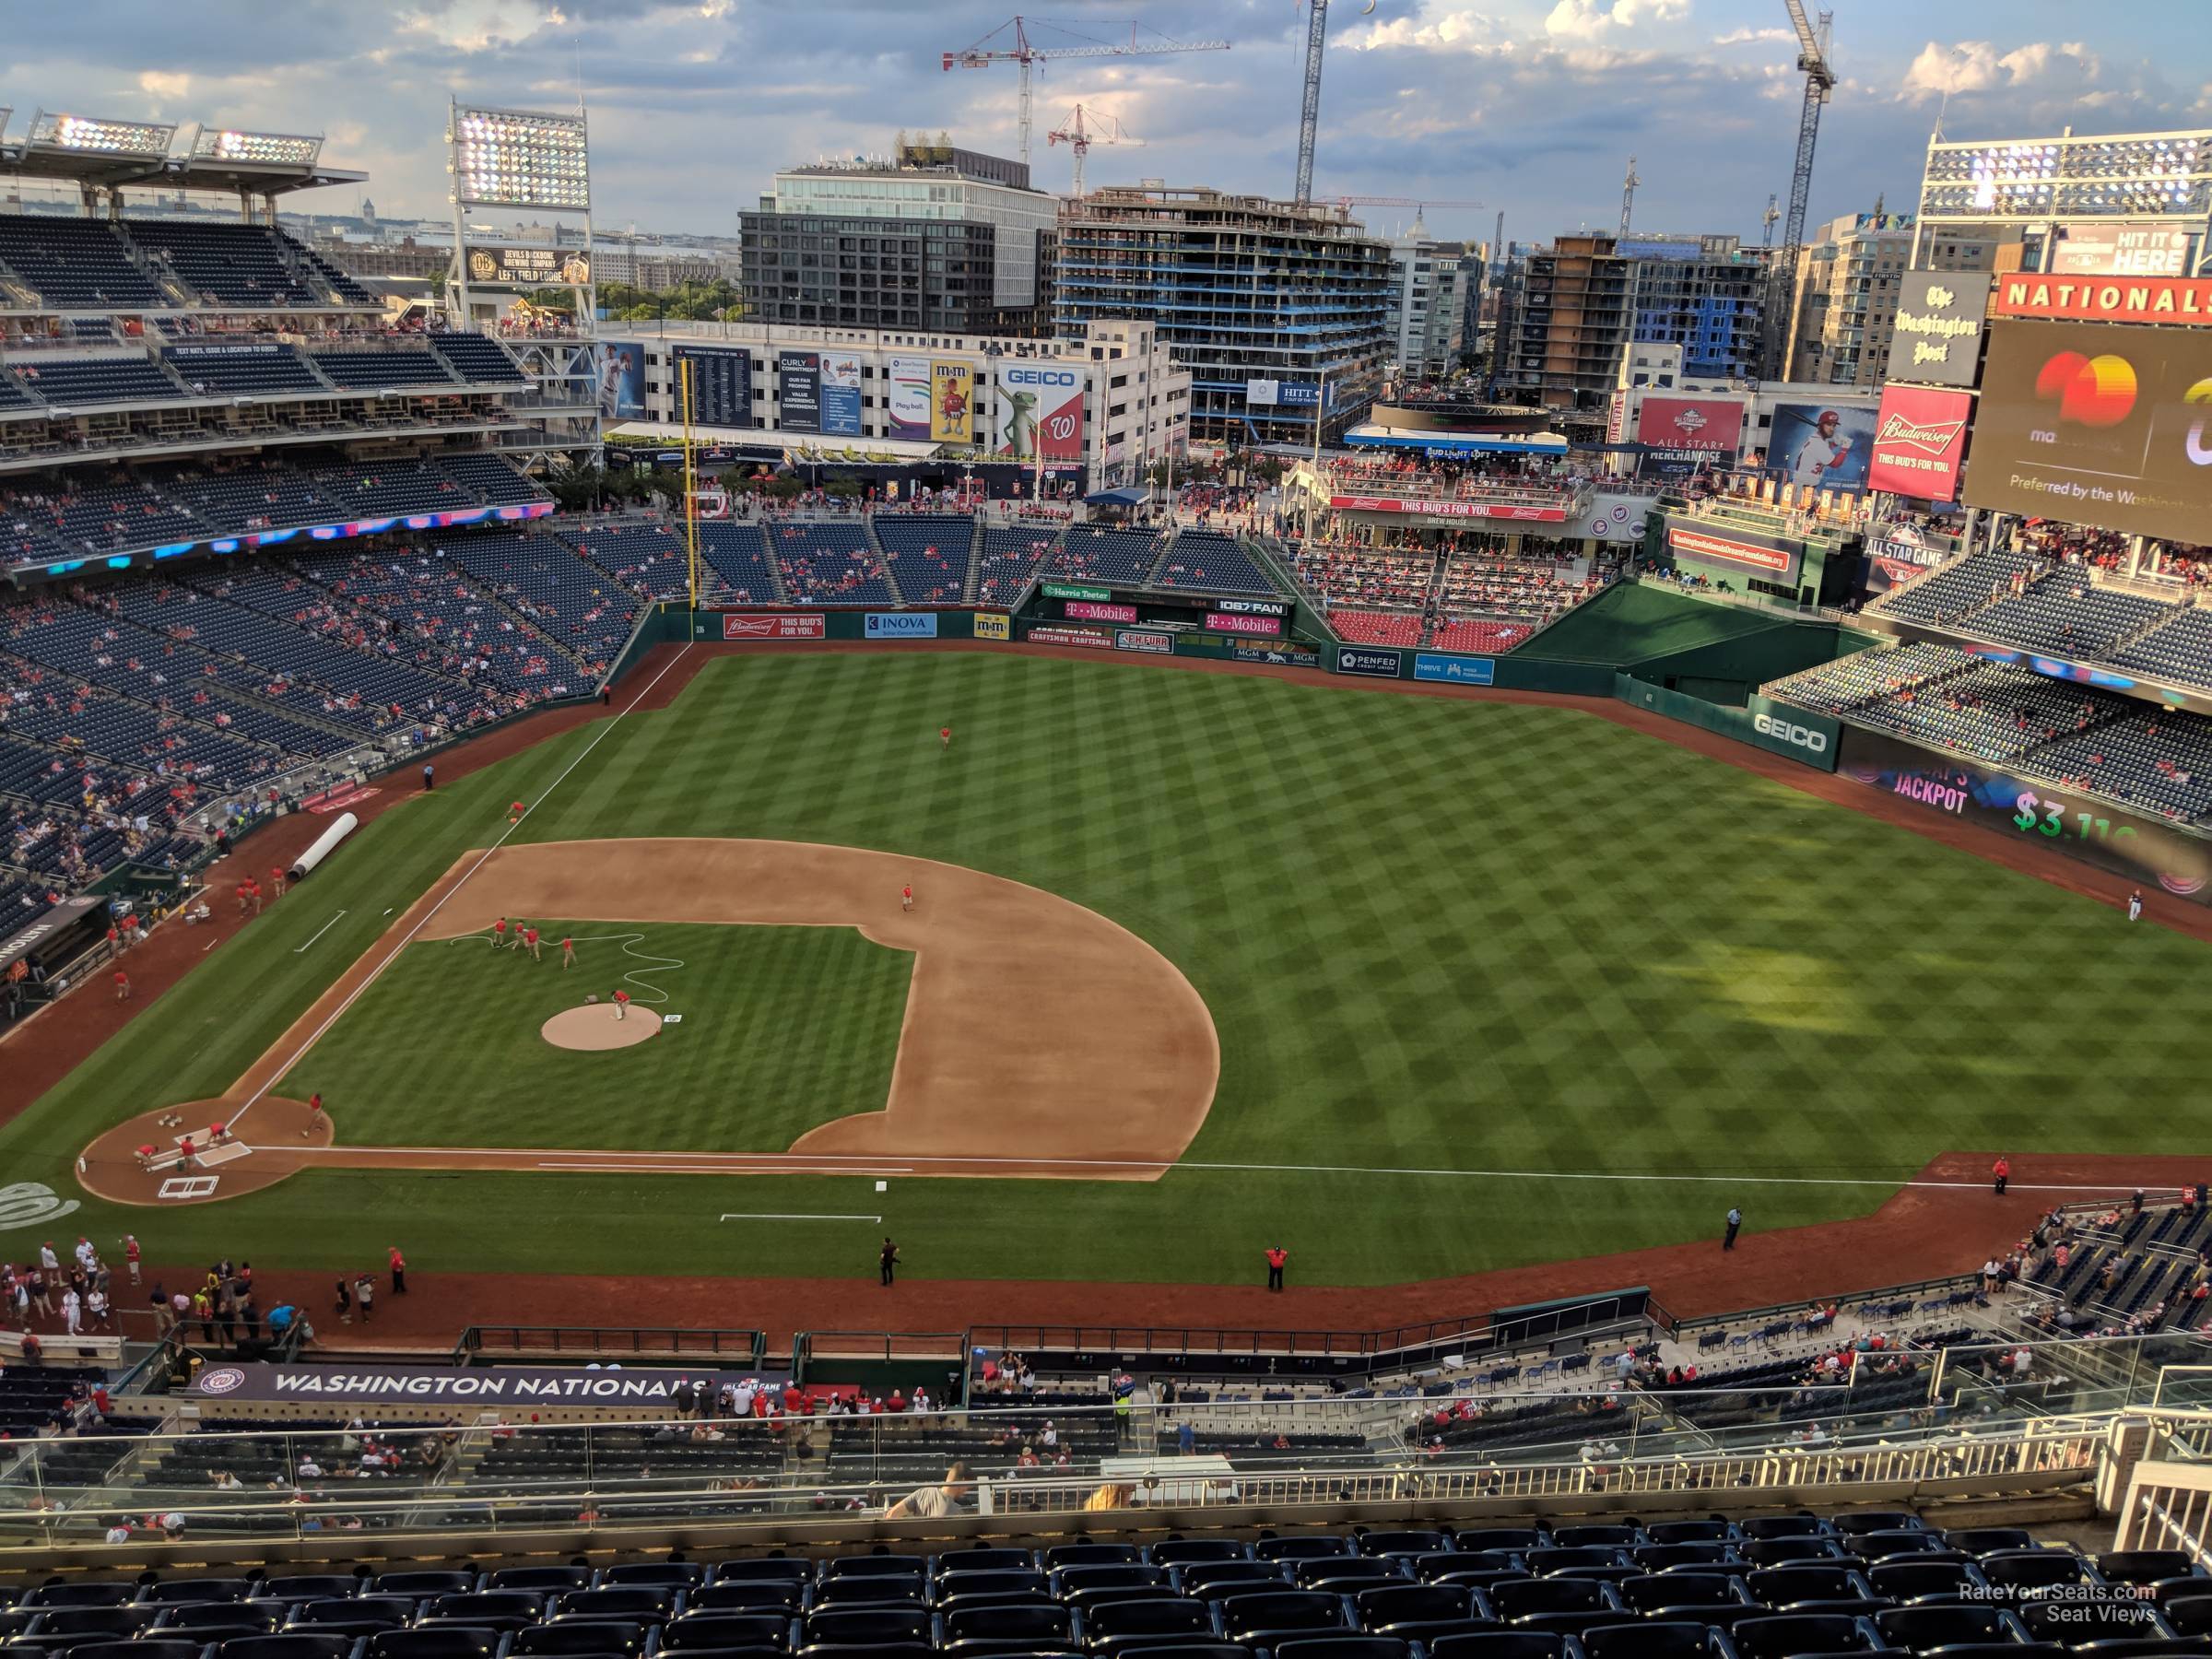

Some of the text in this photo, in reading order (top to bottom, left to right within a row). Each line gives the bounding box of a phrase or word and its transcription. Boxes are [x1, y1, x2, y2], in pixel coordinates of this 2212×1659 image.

[2118, 232, 2169, 247] HIT IT
[525, 251, 554, 260] BACKBONE
[2113, 249, 2183, 271] HERE
[504, 259, 556, 268] BREWING COMPANY
[499, 269, 563, 282] LEFT FIELD LODGE
[1926, 286, 1955, 309] The
[1894, 308, 1979, 338] Washington
[1913, 341, 1949, 366] Post
[782, 359, 806, 367] CURLY
[1007, 369, 1075, 386] GEICO
[1284, 388, 1312, 397] HITT
[896, 402, 911, 410] Play
[1884, 421, 1951, 443] Budweiser
[1657, 439, 1717, 449] ALL STAR
[1428, 448, 1490, 459] BUD LIGHT LOFT
[1878, 453, 1949, 472] THIS BUD'S FOR YOU.
[2009, 474, 2069, 495] Preferred
[2073, 483, 2088, 500] by
[2090, 487, 2113, 501] the
[1400, 500, 1420, 512] THIS
[1422, 502, 1450, 513] BUD'S
[1452, 503, 1469, 514] FOR
[1471, 504, 1492, 516] YOU.
[1427, 516, 1467, 526] BREW HOUSE
[1865, 539, 1884, 556] ALL
[1885, 542, 1912, 562] STAR
[1912, 547, 1943, 568] GAME
[1054, 588, 1108, 599] Harris Teeter
[1253, 604, 1283, 614] FAN
[732, 621, 771, 631] Budweiser
[781, 618, 822, 627] THIS BUD'S
[883, 618, 925, 629] INOVA
[781, 627, 815, 635] FOR YOU.
[1030, 632, 1069, 642] CRAFTSMAN
[1072, 636, 1112, 647] CRAFTSMAN
[1237, 649, 1260, 657] MGM
[1293, 653, 1315, 662] MGM
[1358, 655, 1396, 665] PENFED
[1417, 664, 1441, 672] THRIVE
[1754, 713, 1827, 752] GEICO
[1894, 772, 1968, 814] JACKPOT
[276, 1374, 504, 1395] WASHINGTON
